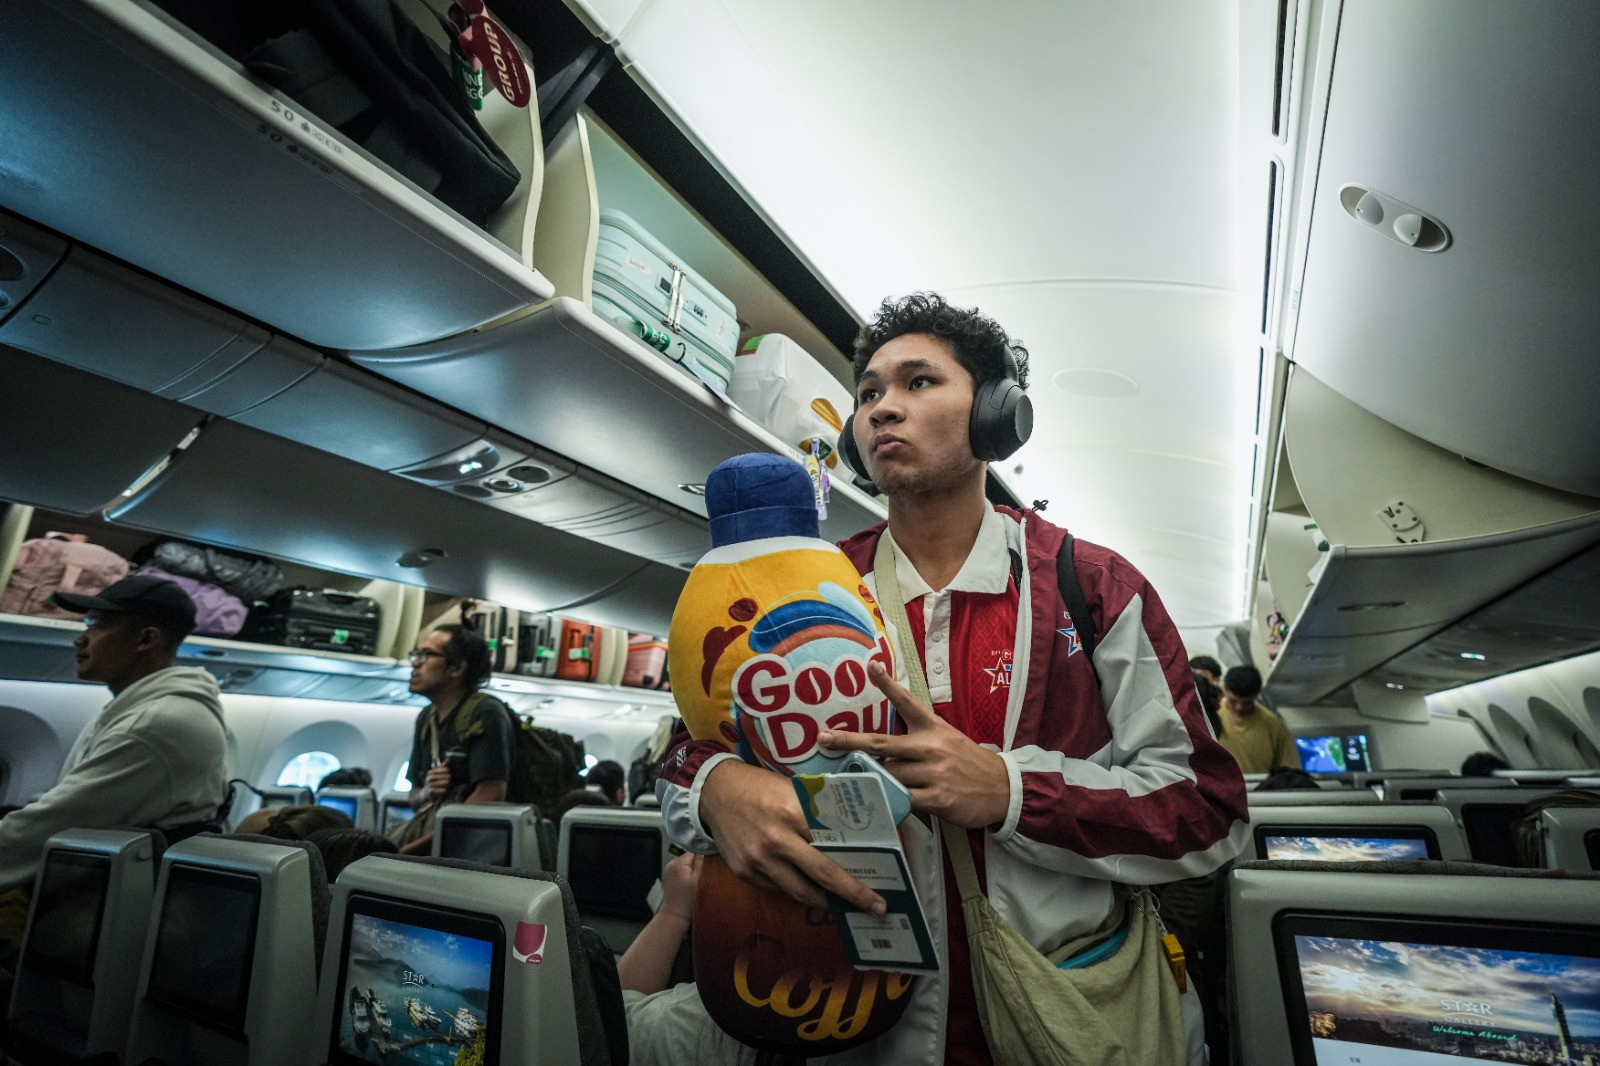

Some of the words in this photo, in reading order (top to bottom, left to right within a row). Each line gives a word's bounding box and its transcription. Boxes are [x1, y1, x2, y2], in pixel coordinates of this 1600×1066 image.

[483, 22, 515, 102] GROUP
[271, 100, 294, 121] 50
[737, 636, 893, 713] Good
[1432, 1025, 1475, 1037] Welcome
[1478, 1031, 1517, 1041] Aboard
